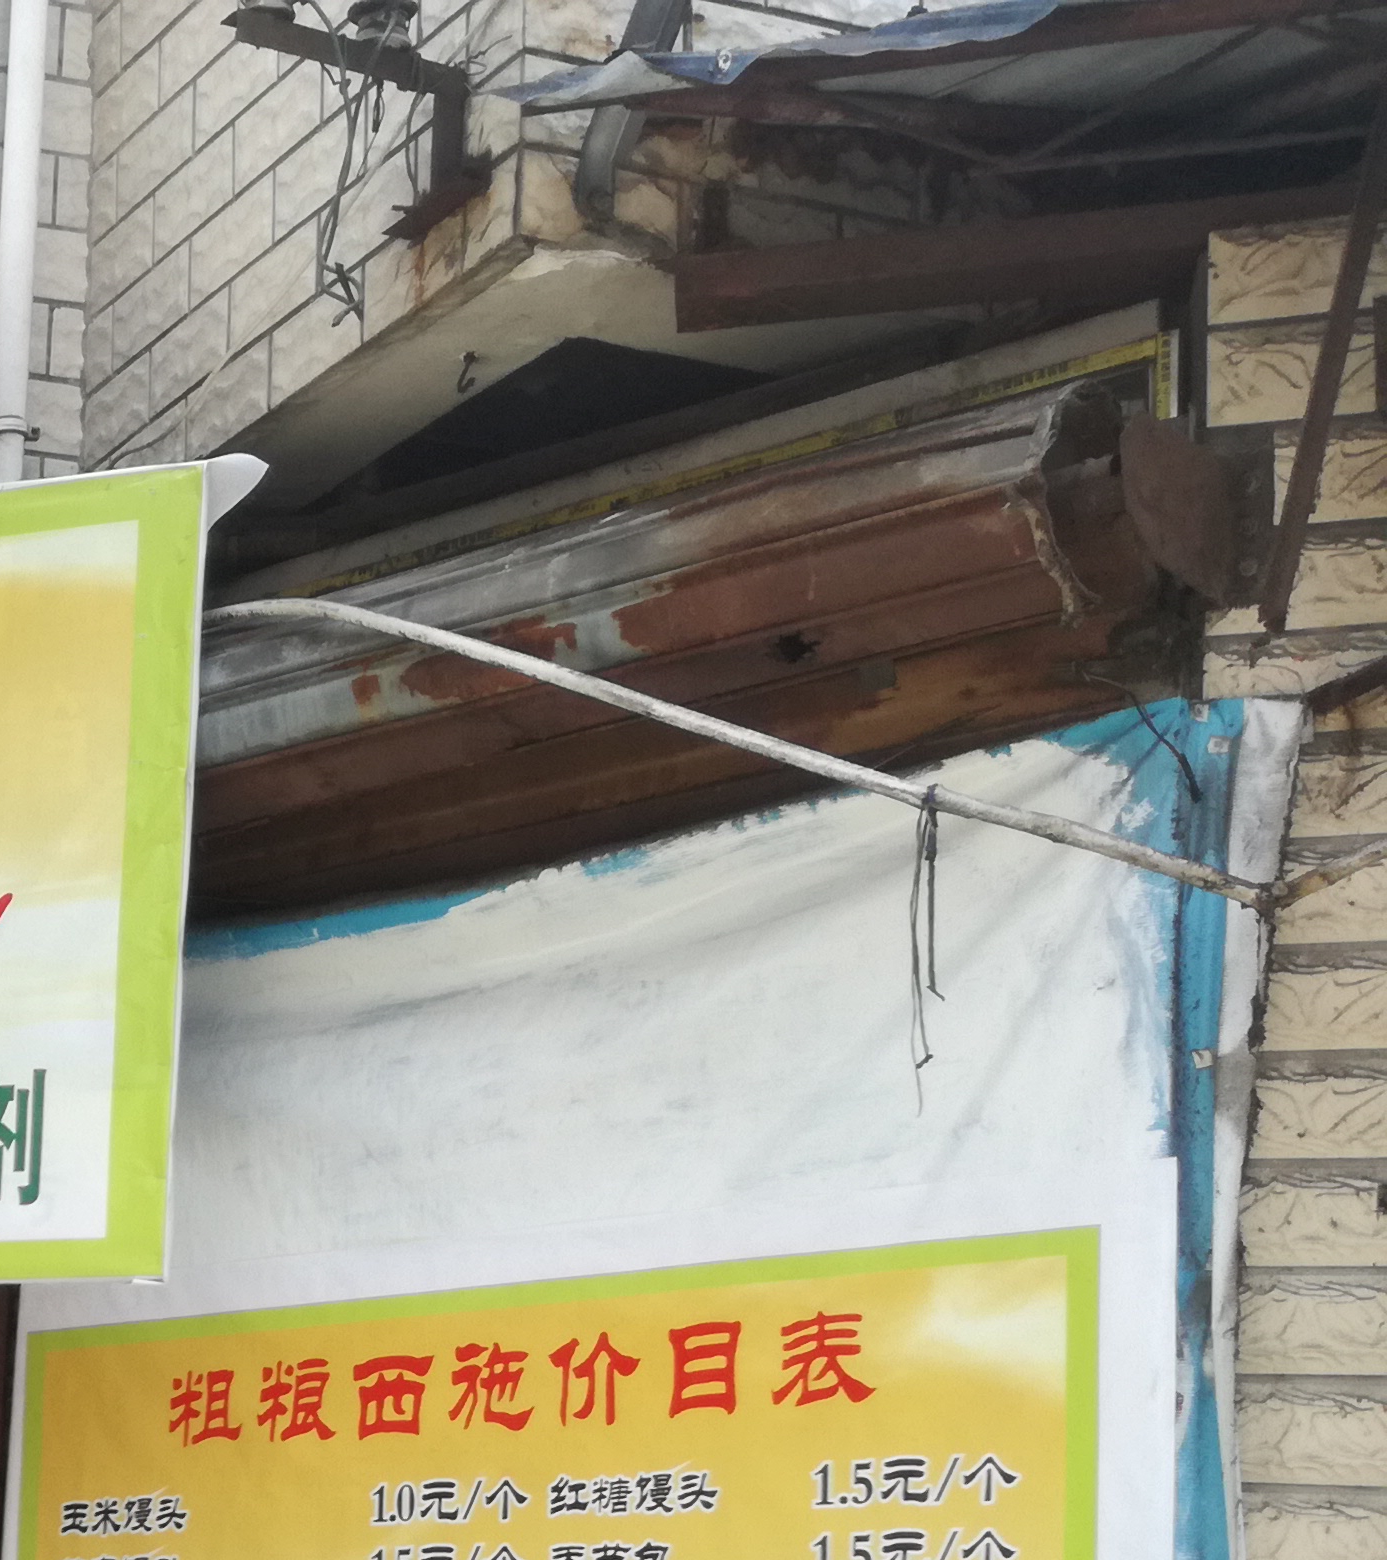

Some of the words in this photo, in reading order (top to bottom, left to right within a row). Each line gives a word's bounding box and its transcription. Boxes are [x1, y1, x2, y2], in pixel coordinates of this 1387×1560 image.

[166, 1310, 878, 1448] 粗粮西施价目表
[61, 1498, 187, 1534] 玉米馒头
[371, 1480, 527, 1522] 1.0元/个
[549, 1473, 717, 1514] 红糖馒头
[814, 1457, 1017, 1505] 1.5元/个
